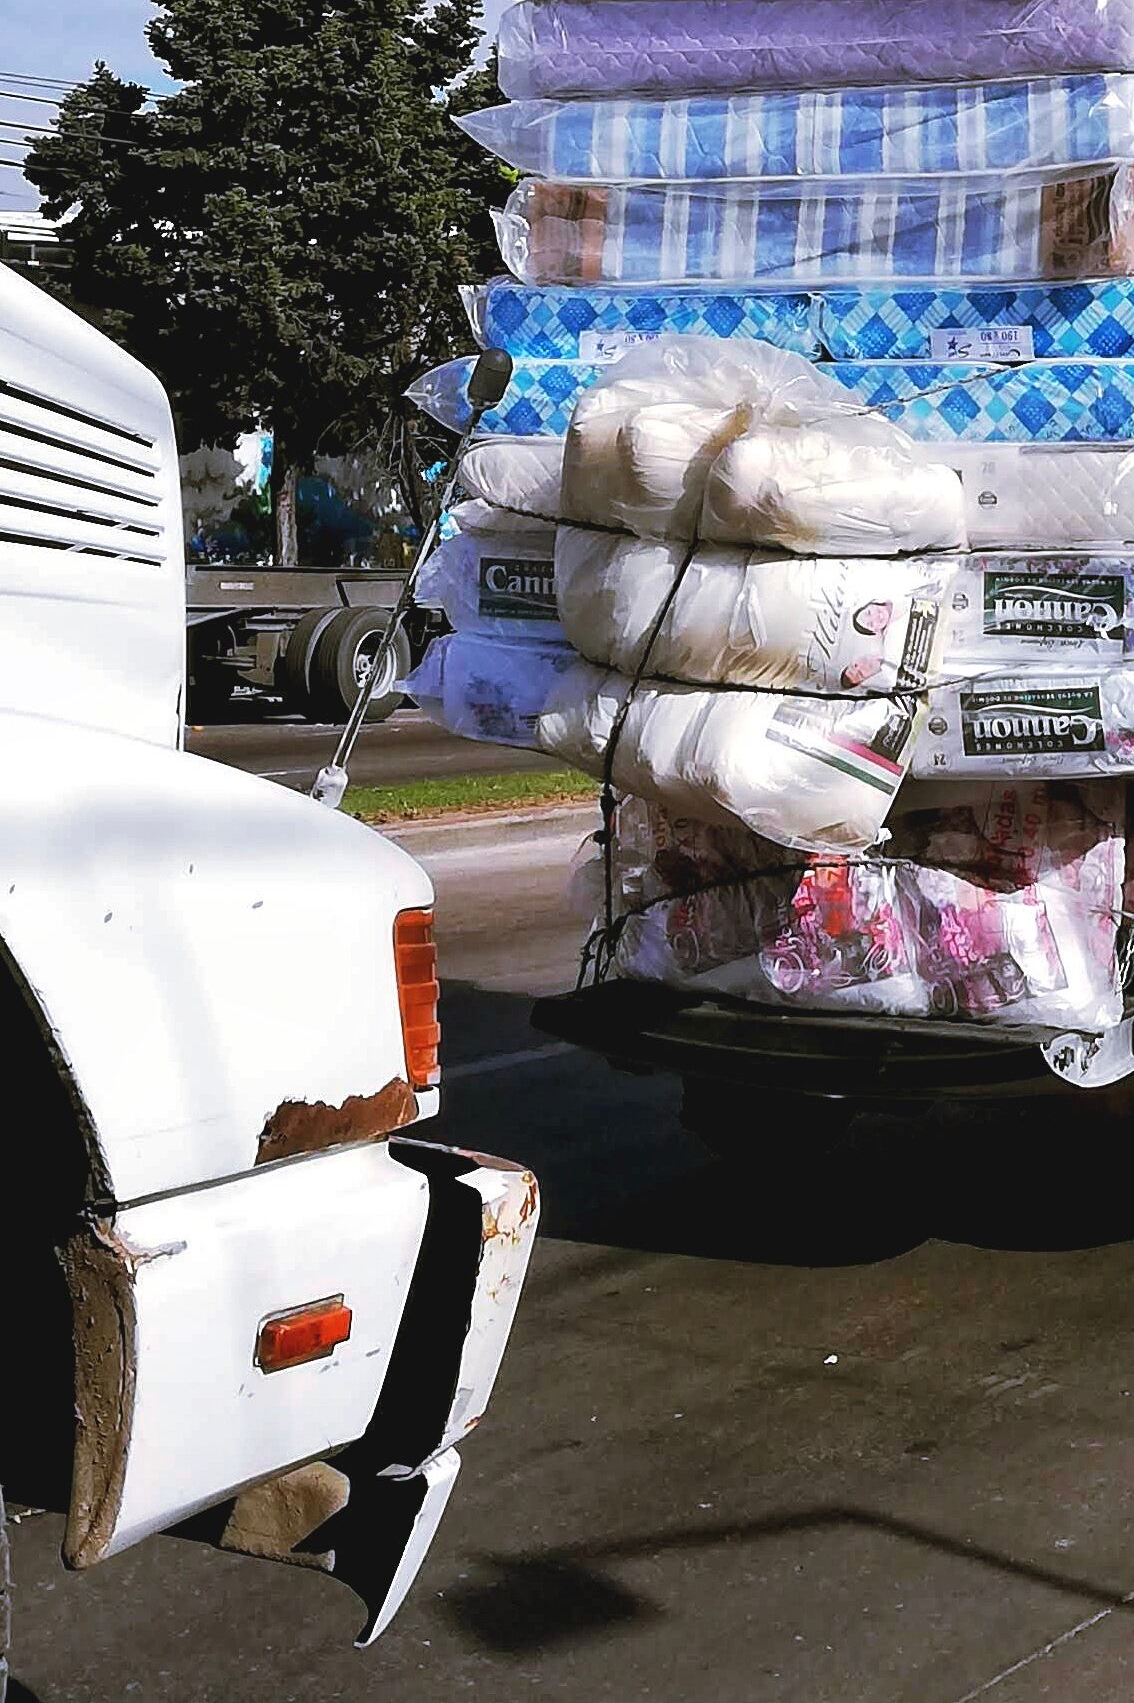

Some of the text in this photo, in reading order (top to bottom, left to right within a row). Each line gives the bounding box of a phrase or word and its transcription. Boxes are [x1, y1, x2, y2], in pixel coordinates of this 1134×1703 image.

[994, 598, 1118, 632] Cannon
[973, 715, 1098, 745] Cannon
[976, 740, 1063, 751] COLCHONES
